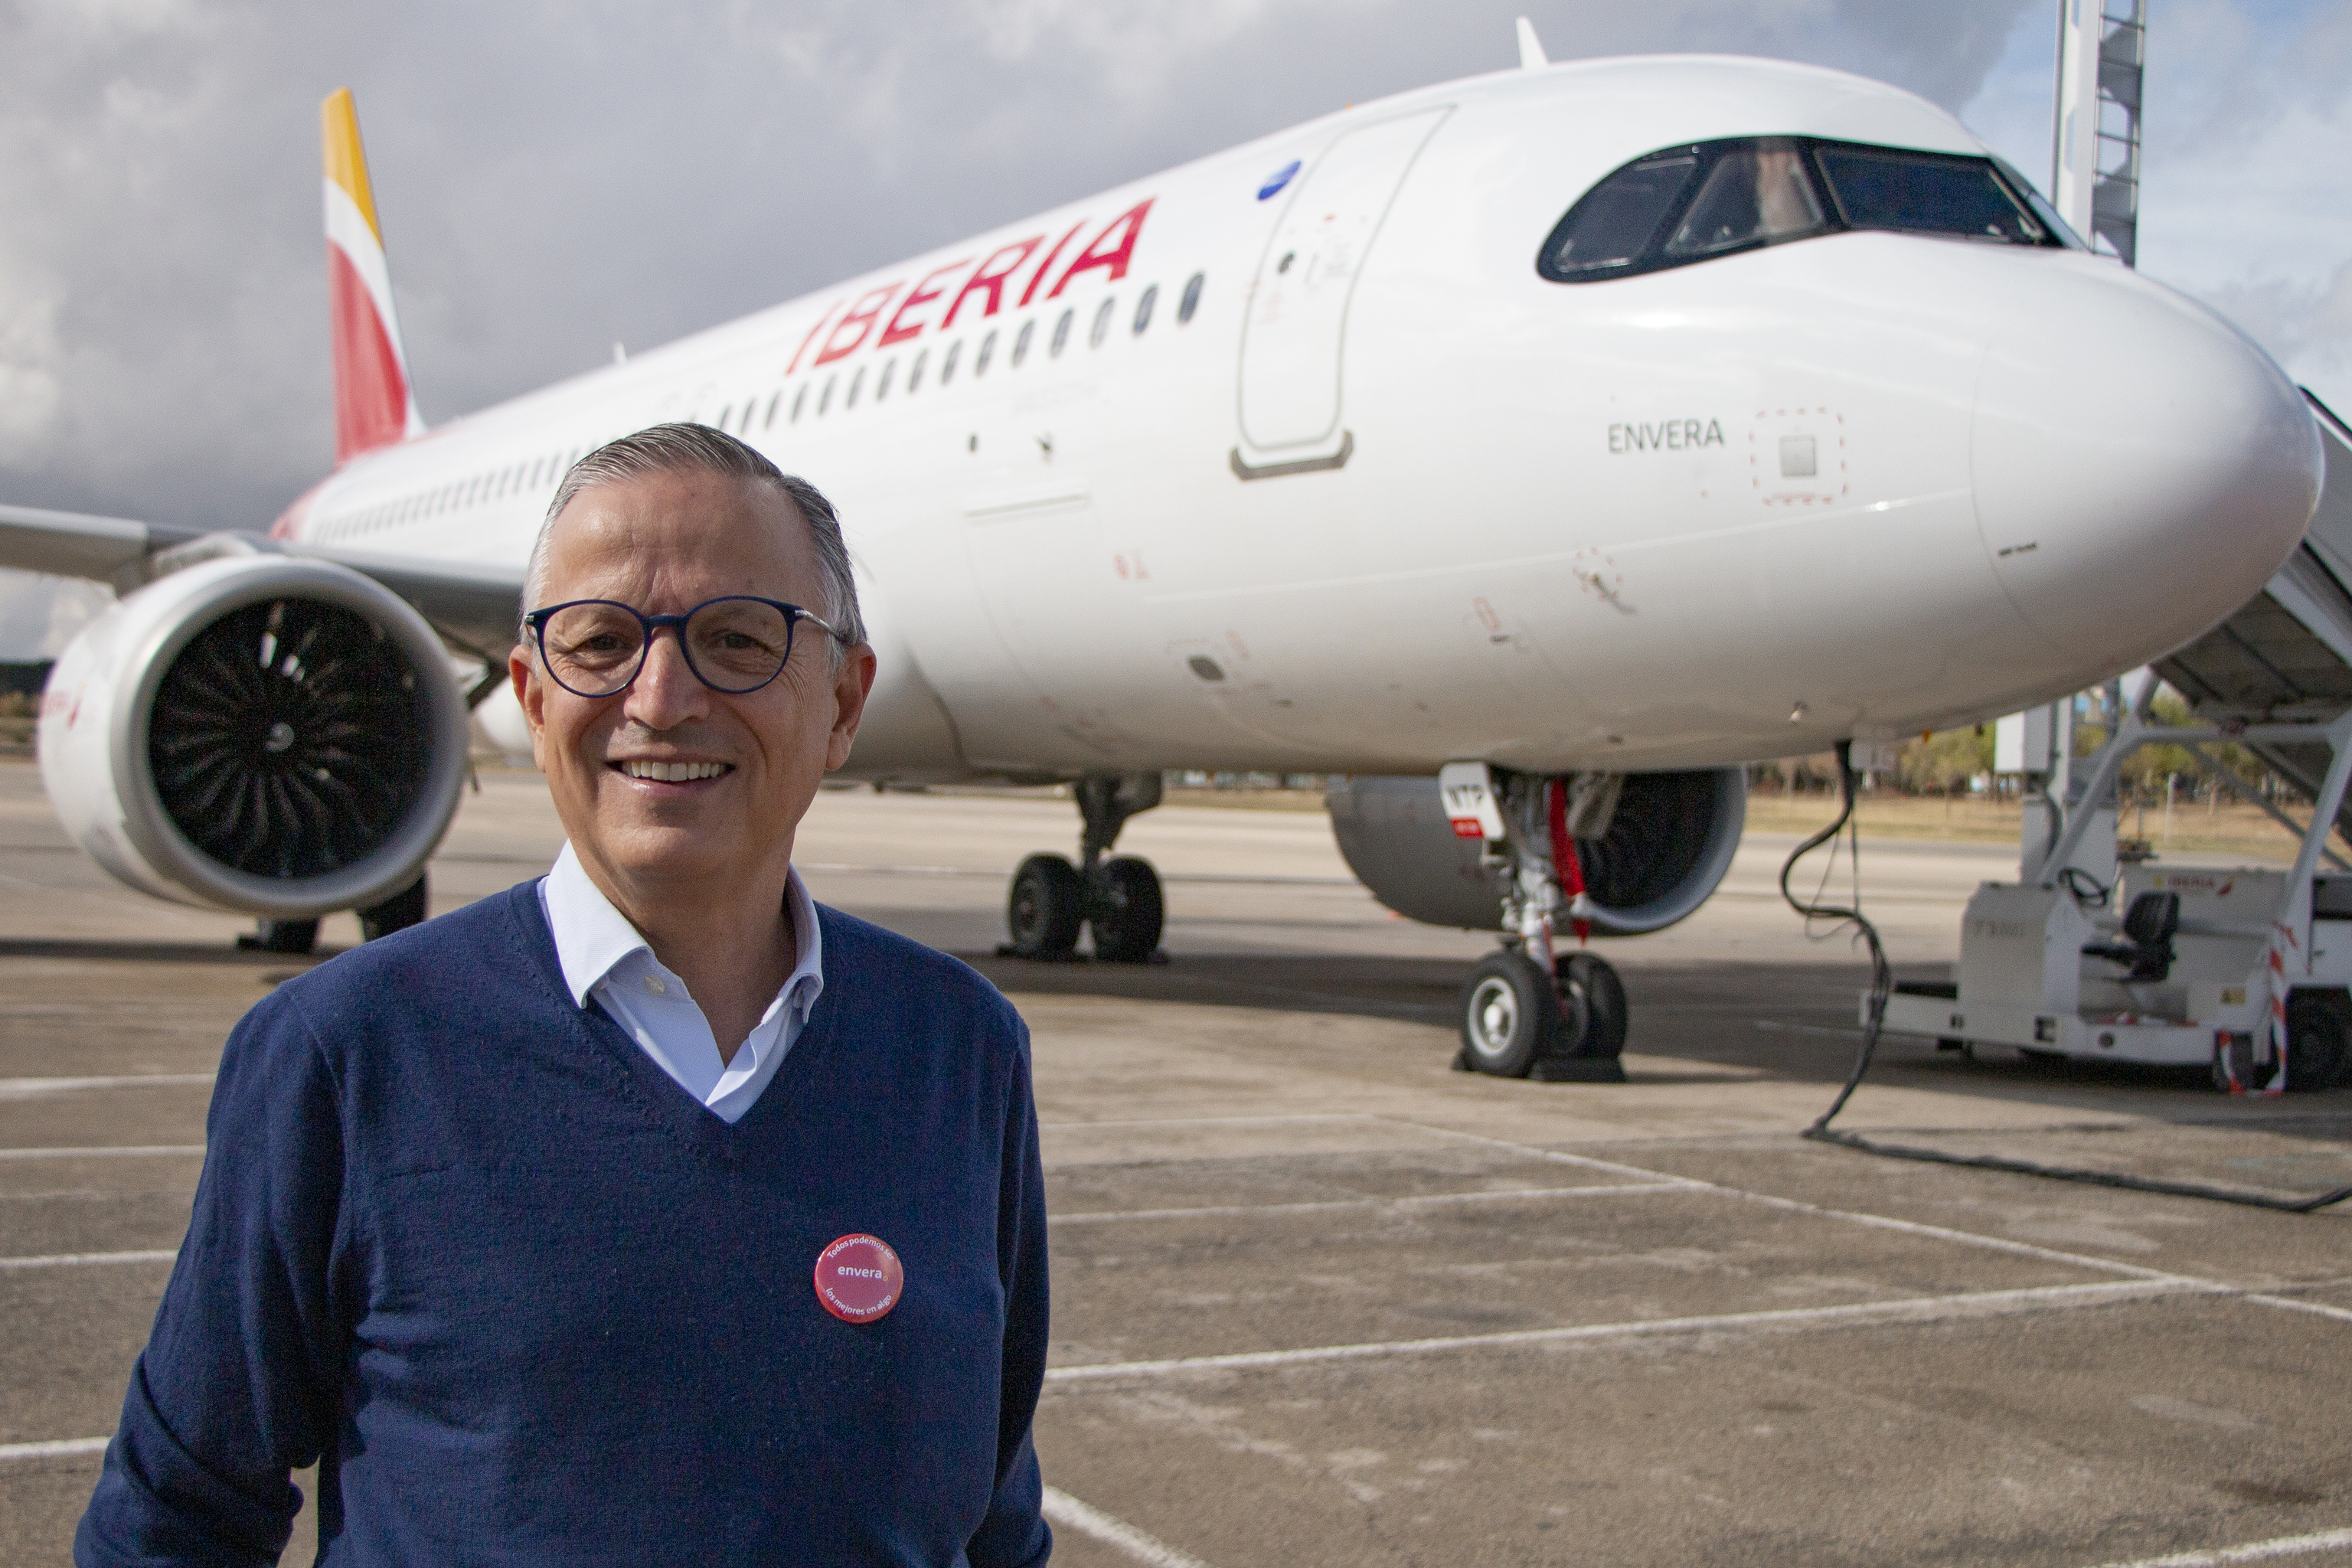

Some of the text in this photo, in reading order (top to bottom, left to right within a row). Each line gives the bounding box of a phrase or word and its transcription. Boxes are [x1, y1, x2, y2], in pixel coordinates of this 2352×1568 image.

[784, 195, 1158, 376] IBERIA
[1608, 417, 1726, 454] ENVERA
[827, 1236, 895, 1260] Todos podemos ser
[838, 1266, 883, 1279] envera
[826, 1287, 892, 1315] los mejores en algo
